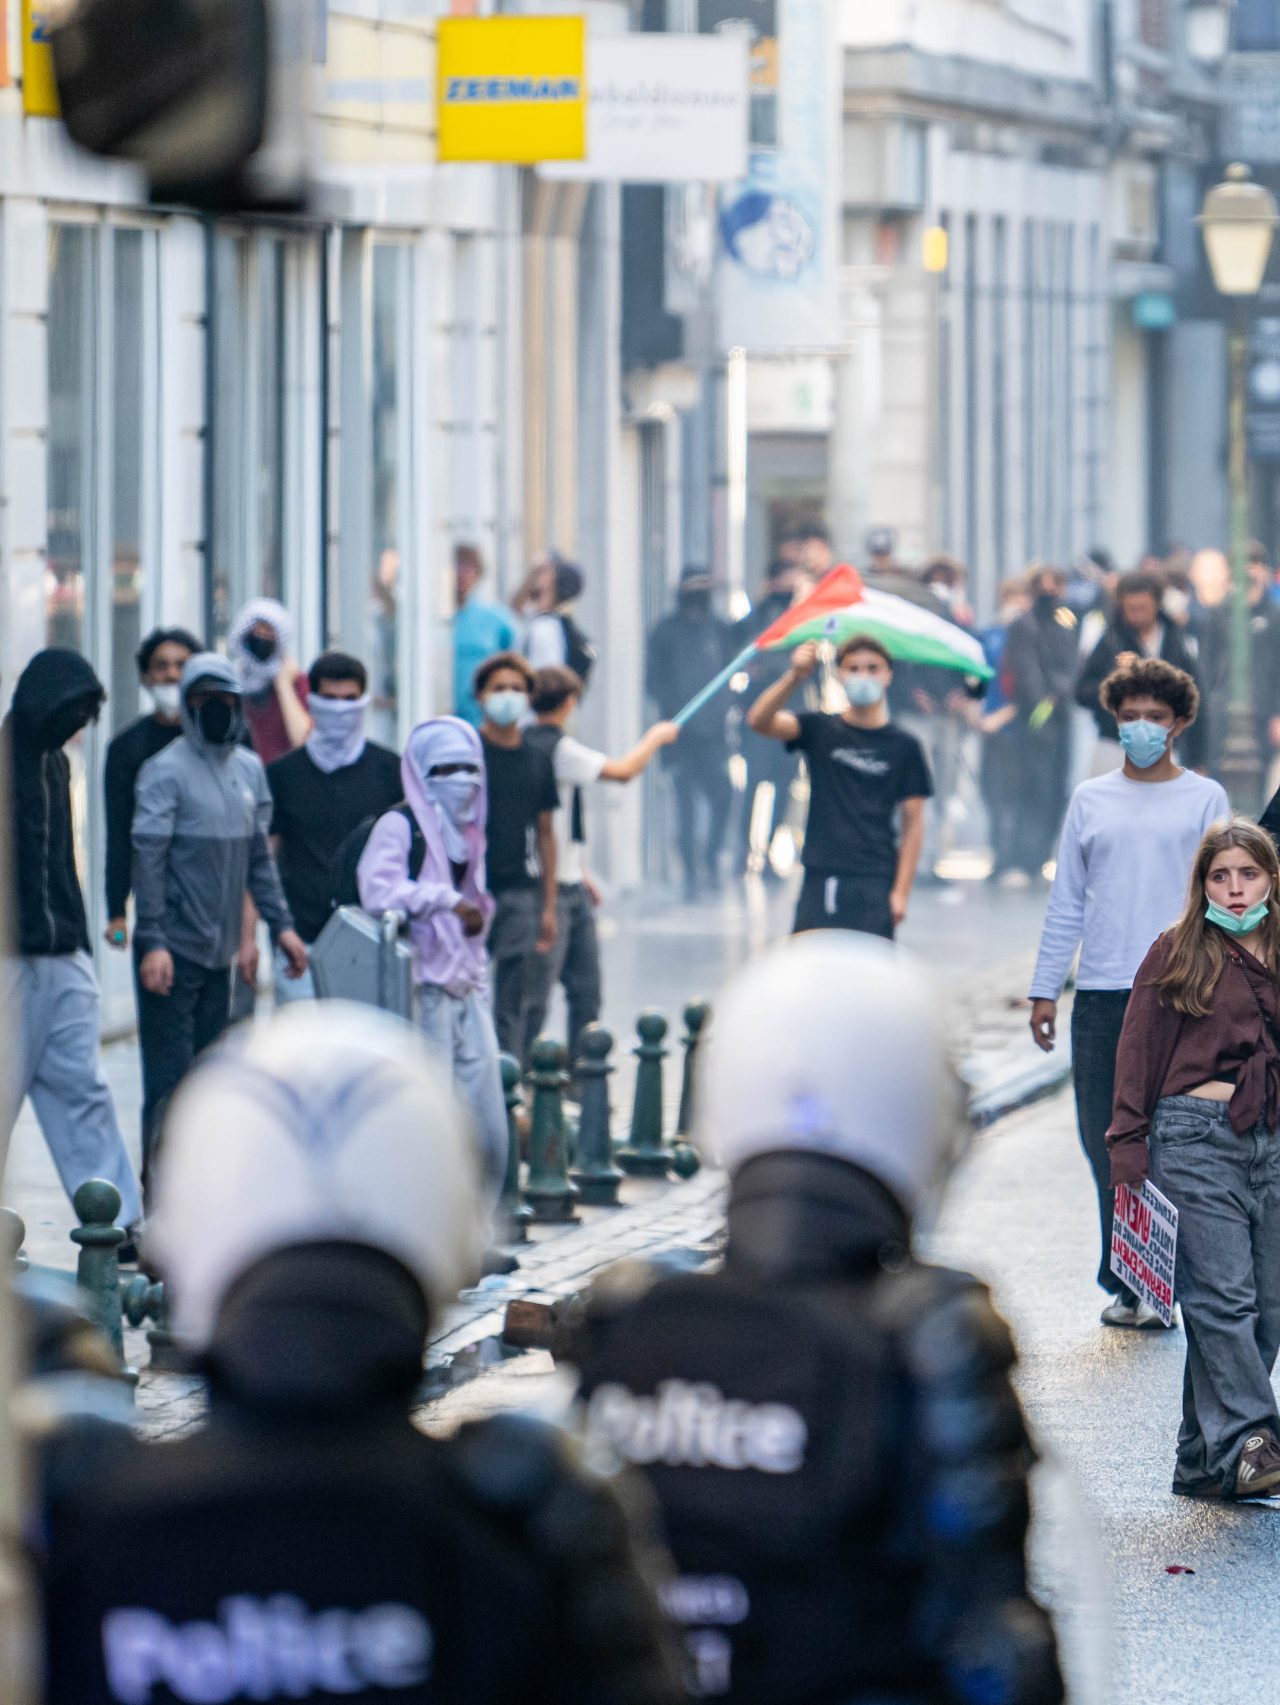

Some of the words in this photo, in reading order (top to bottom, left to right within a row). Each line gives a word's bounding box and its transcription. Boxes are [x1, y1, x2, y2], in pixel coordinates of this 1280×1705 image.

[446, 75, 579, 102] ZEEMAN
[1114, 1182, 1151, 1245] AVENIR
[1114, 1218, 1122, 1236] DE
[583, 1378, 808, 1476] Police
[101, 1592, 434, 1704] Police
